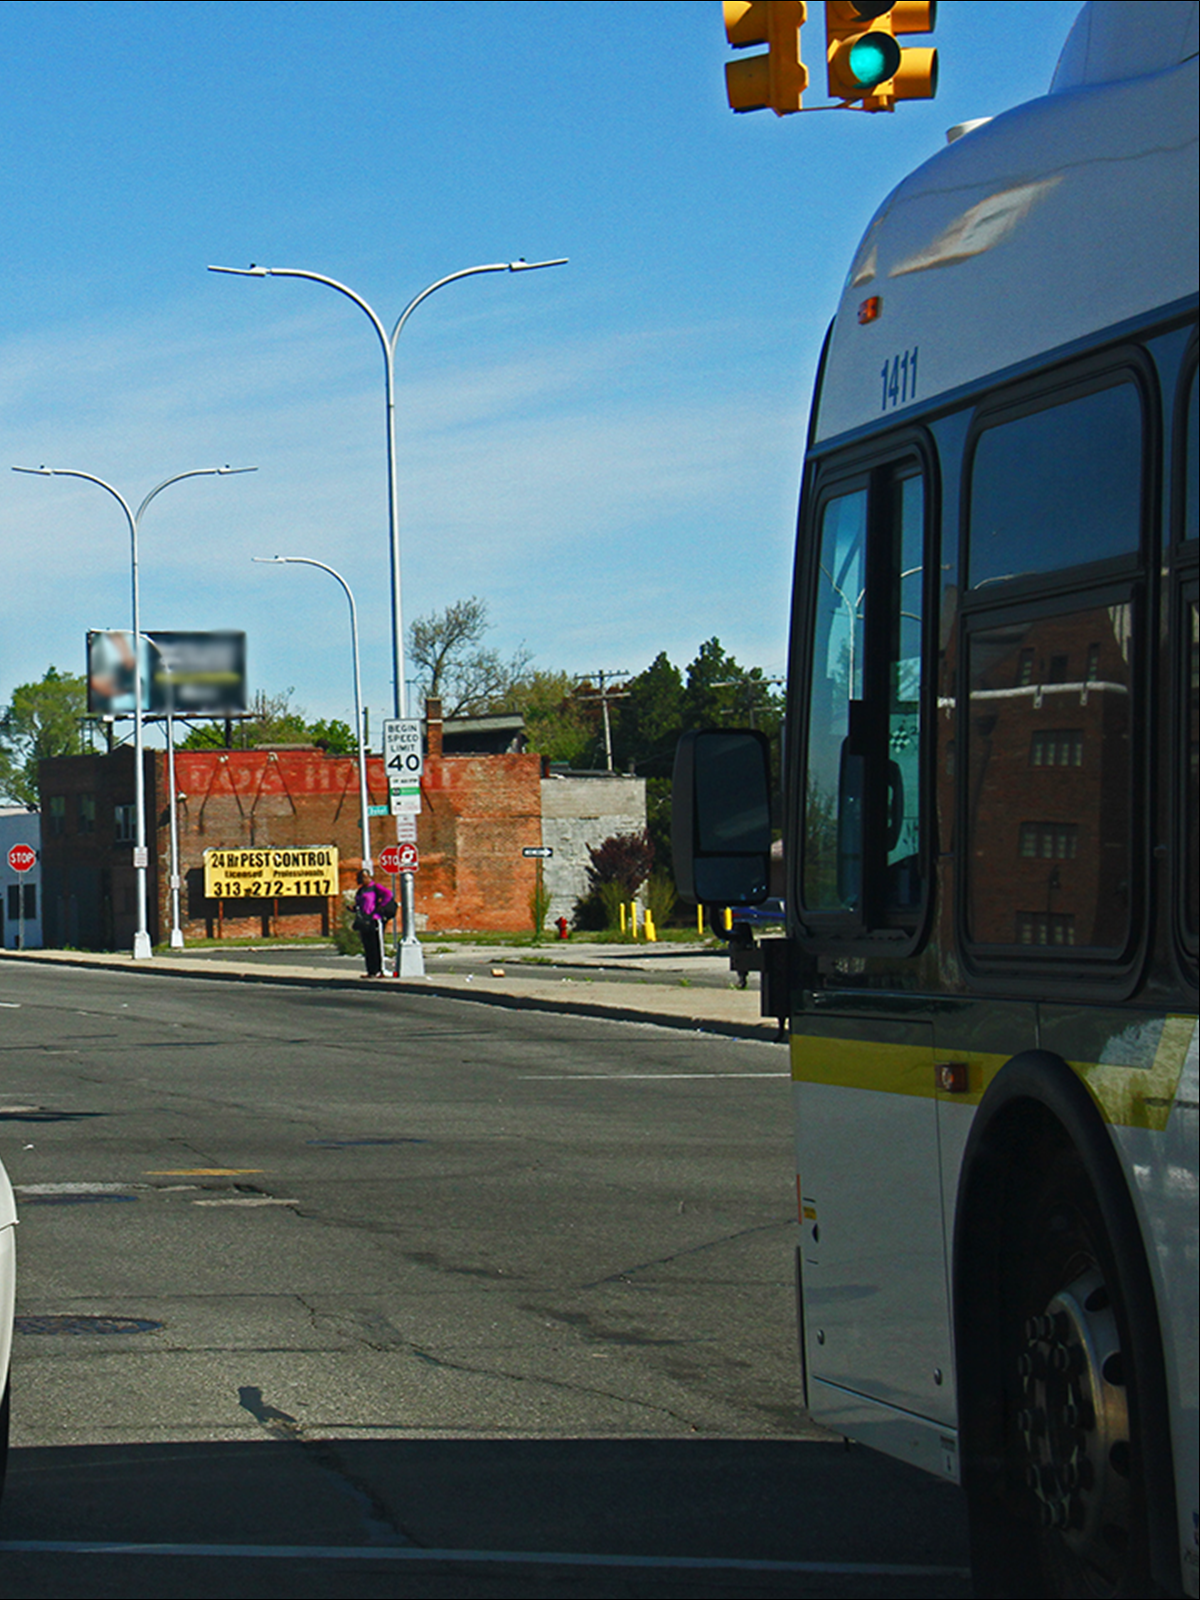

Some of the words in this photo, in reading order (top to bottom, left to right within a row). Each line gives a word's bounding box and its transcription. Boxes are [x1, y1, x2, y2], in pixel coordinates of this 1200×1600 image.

[880, 345, 919, 411] 1411
[387, 724, 418, 733] BEGIN
[387, 734, 419, 743] SPEED
[390, 744, 415, 753] LIMIT
[387, 753, 420, 771] 40
[10, 852, 35, 864] STOP
[211, 853, 225, 868] 24
[240, 852, 271, 868] PEST
[273, 851, 332, 868] CONTROL
[381, 855, 400, 866] STO
[225, 869, 263, 879] Licensed
[213, 880, 331, 896] 313-272-1117
